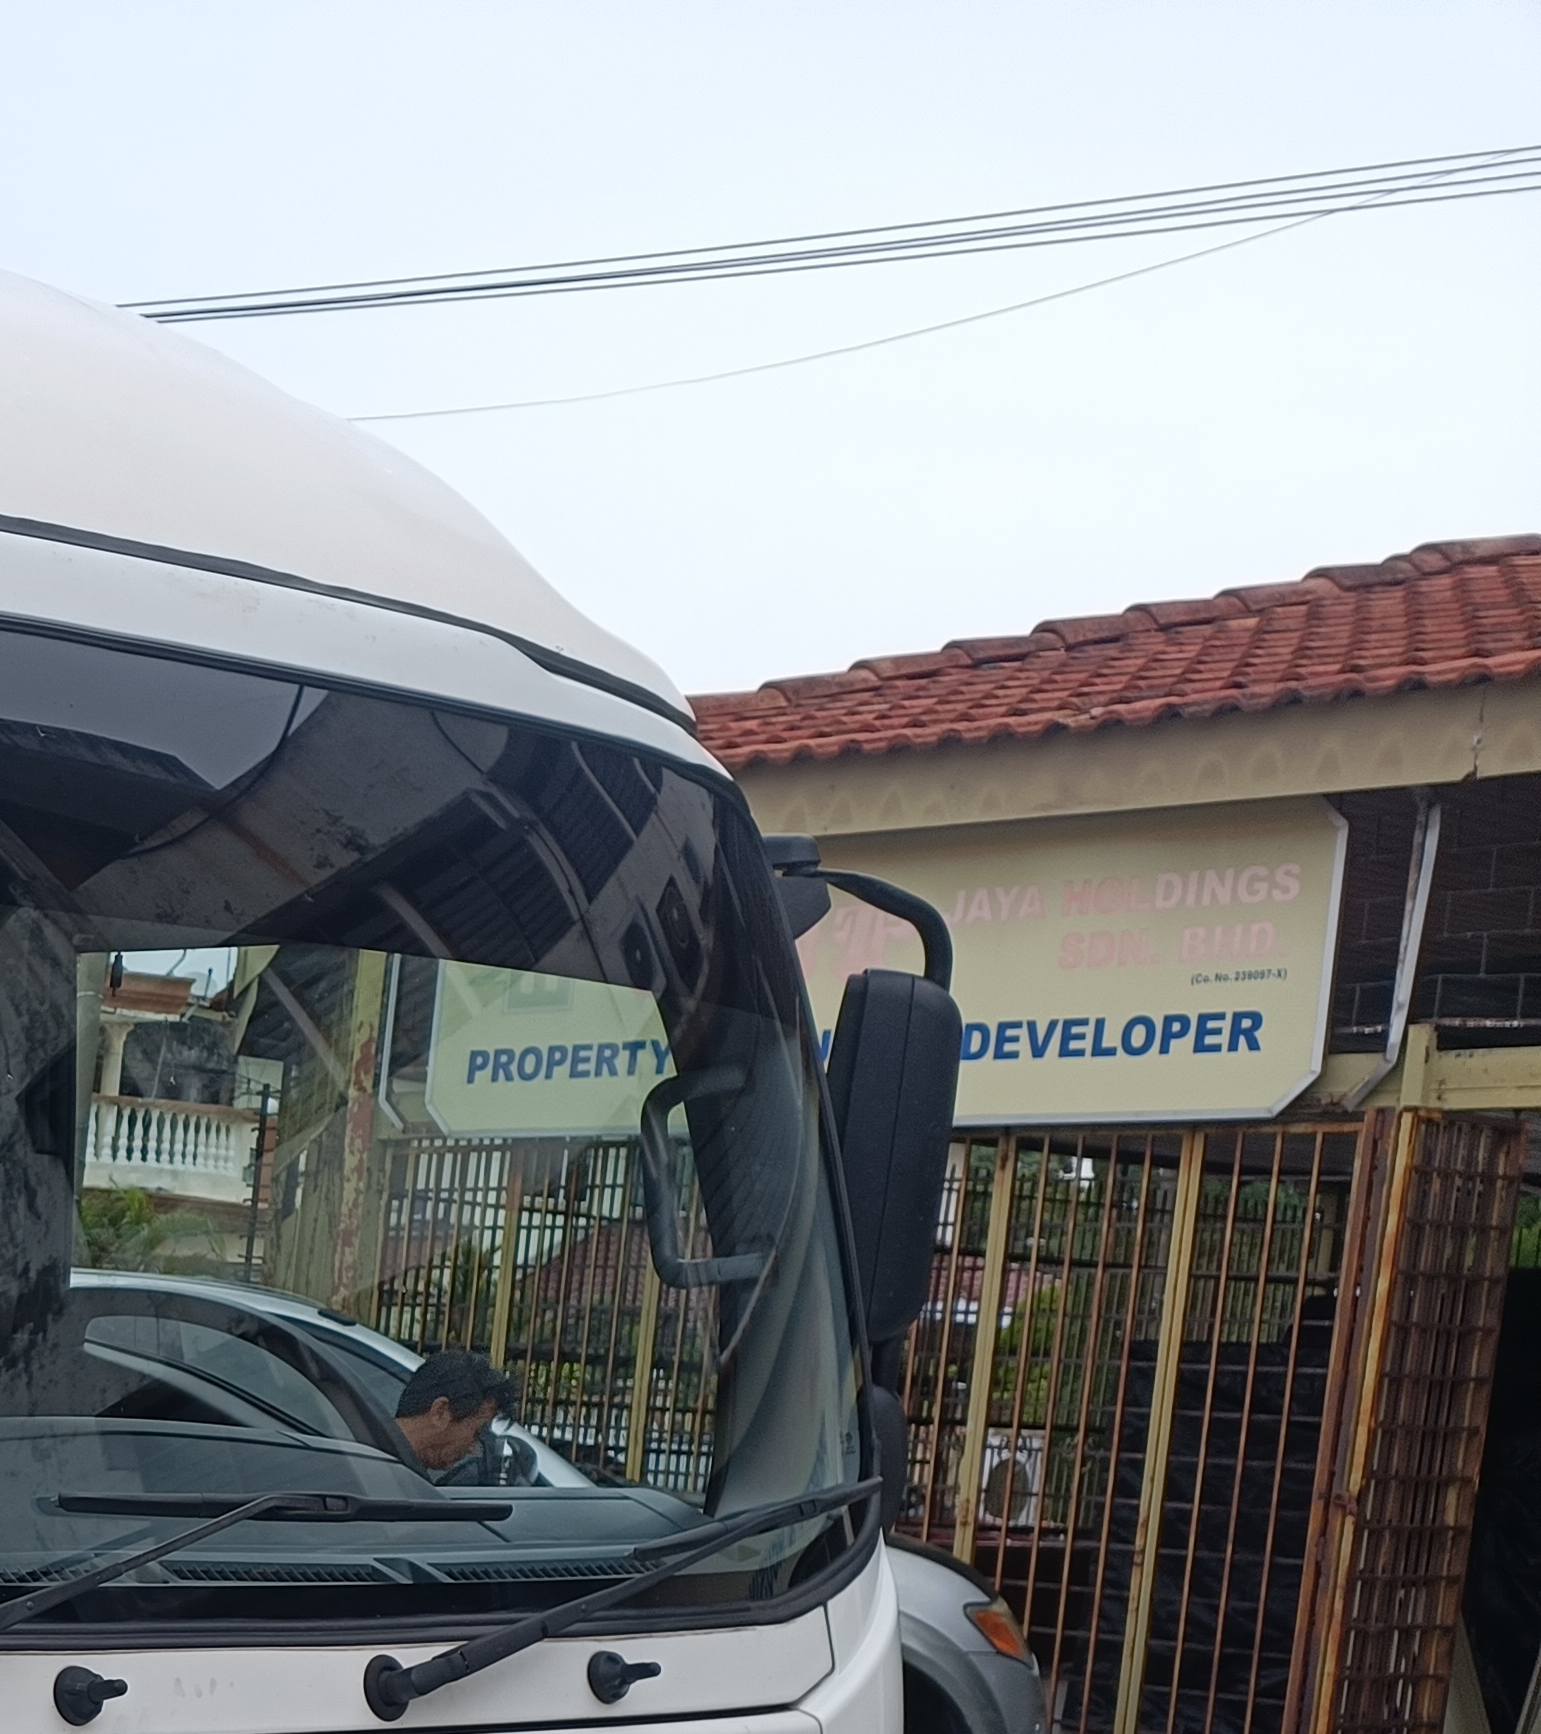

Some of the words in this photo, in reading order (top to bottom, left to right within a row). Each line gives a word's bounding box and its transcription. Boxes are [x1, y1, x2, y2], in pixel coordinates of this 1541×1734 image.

[1060, 862, 1302, 917] HOLDINGS
[466, 1038, 676, 1084] PROPERTY
[960, 1010, 1264, 1062] DEVELOPER
